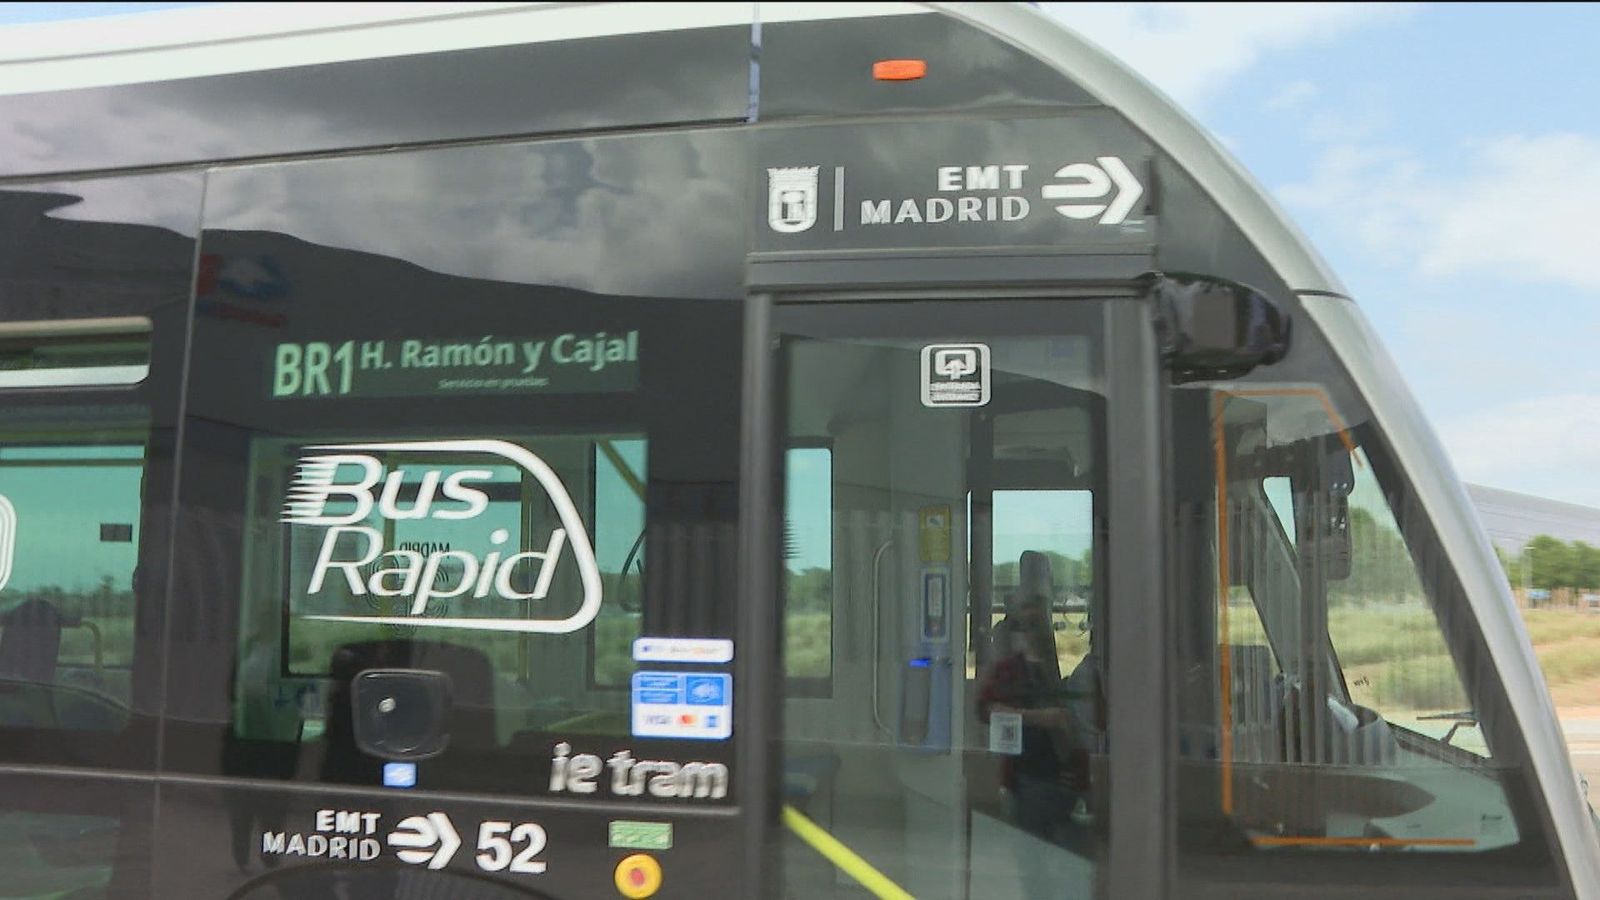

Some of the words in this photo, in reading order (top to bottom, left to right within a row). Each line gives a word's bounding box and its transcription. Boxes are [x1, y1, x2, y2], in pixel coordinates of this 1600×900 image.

[938, 164, 1029, 192] EMT
[860, 196, 1030, 225] MADRID
[272, 339, 355, 398] BR1
[360, 341, 391, 370] H.
[401, 335, 514, 370] Ramón
[521, 341, 546, 374] y
[550, 329, 639, 373] Cajal
[279, 453, 493, 526] Bus
[307, 525, 566, 616] Rapid
[549, 741, 603, 794] ie
[606, 749, 729, 800] tram
[262, 831, 381, 862] MADRID
[315, 809, 381, 834] EMT
[475, 820, 548, 875] 52
